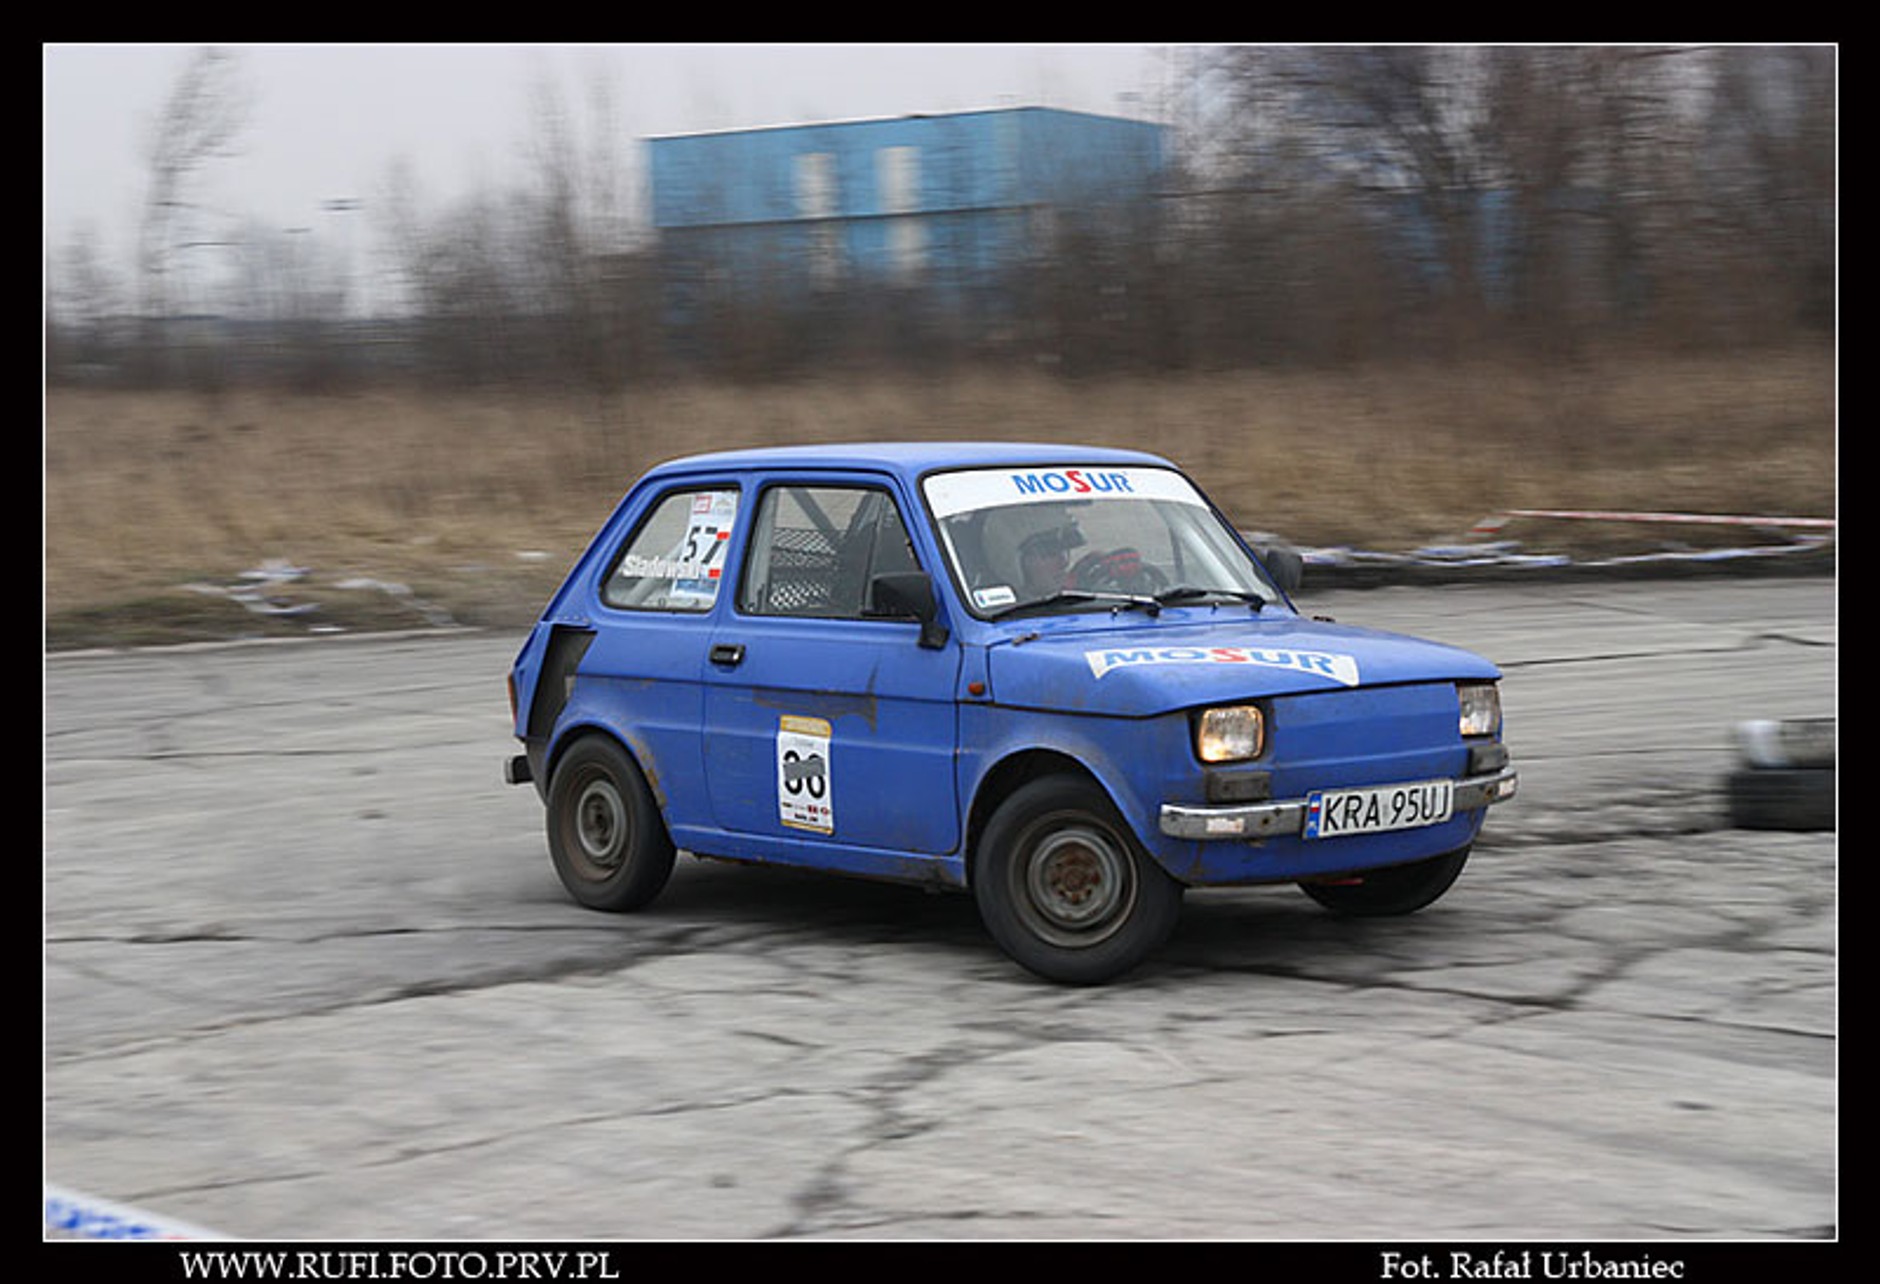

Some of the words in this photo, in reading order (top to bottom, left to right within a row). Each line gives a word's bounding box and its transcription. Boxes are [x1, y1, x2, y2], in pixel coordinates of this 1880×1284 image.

[1011, 470, 1135, 495] MOSUR
[683, 526, 722, 565] 57
[1104, 647, 1336, 675] MOSUR
[1322, 792, 1381, 832] KRA
[1390, 784, 1450, 824] 95UJ
